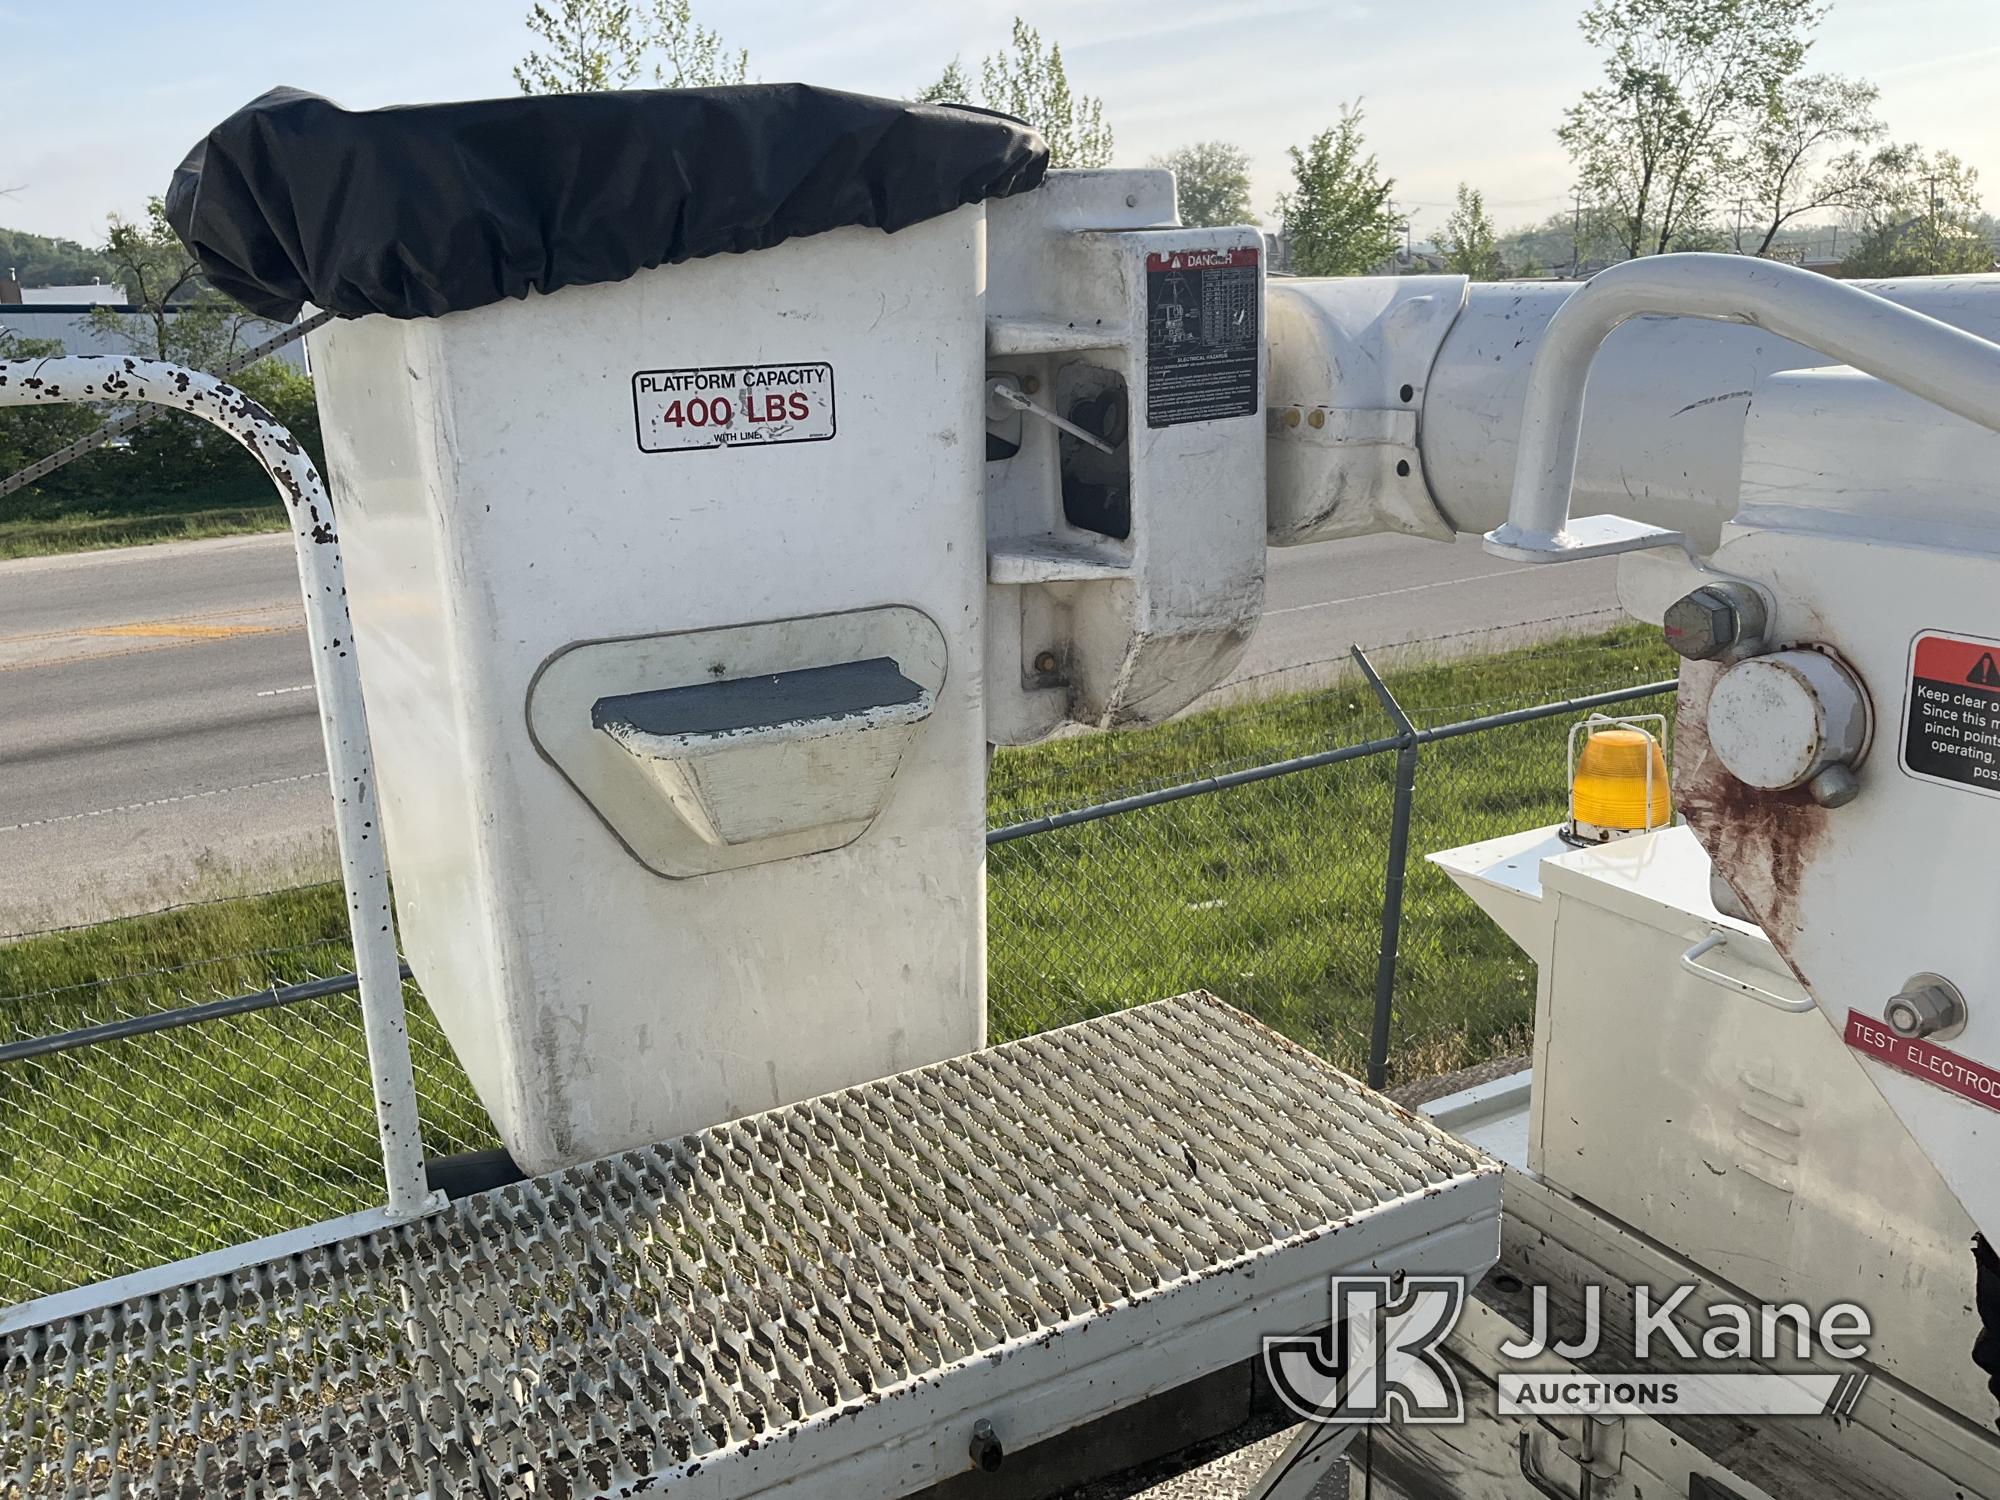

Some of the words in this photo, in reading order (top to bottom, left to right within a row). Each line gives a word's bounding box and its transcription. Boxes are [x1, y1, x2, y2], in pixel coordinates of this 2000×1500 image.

[640, 373, 736, 393] PLATFORM
[743, 368, 825, 387] CAPACITY
[663, 396, 733, 428] 400
[746, 391, 810, 424] LBS
[714, 432, 737, 442] WITH
[740, 431, 763, 441] LINE
[1917, 685, 1950, 704] Keep
[1953, 693, 1988, 710] clear
[1922, 703, 1959, 721] Since
[1962, 711, 1987, 727] this
[1924, 721, 1960, 739] pinch
[1931, 741, 1996, 765] operating,
[1853, 1021, 1899, 1053] TEST
[1907, 1045, 2000, 1100] ELECTROD
